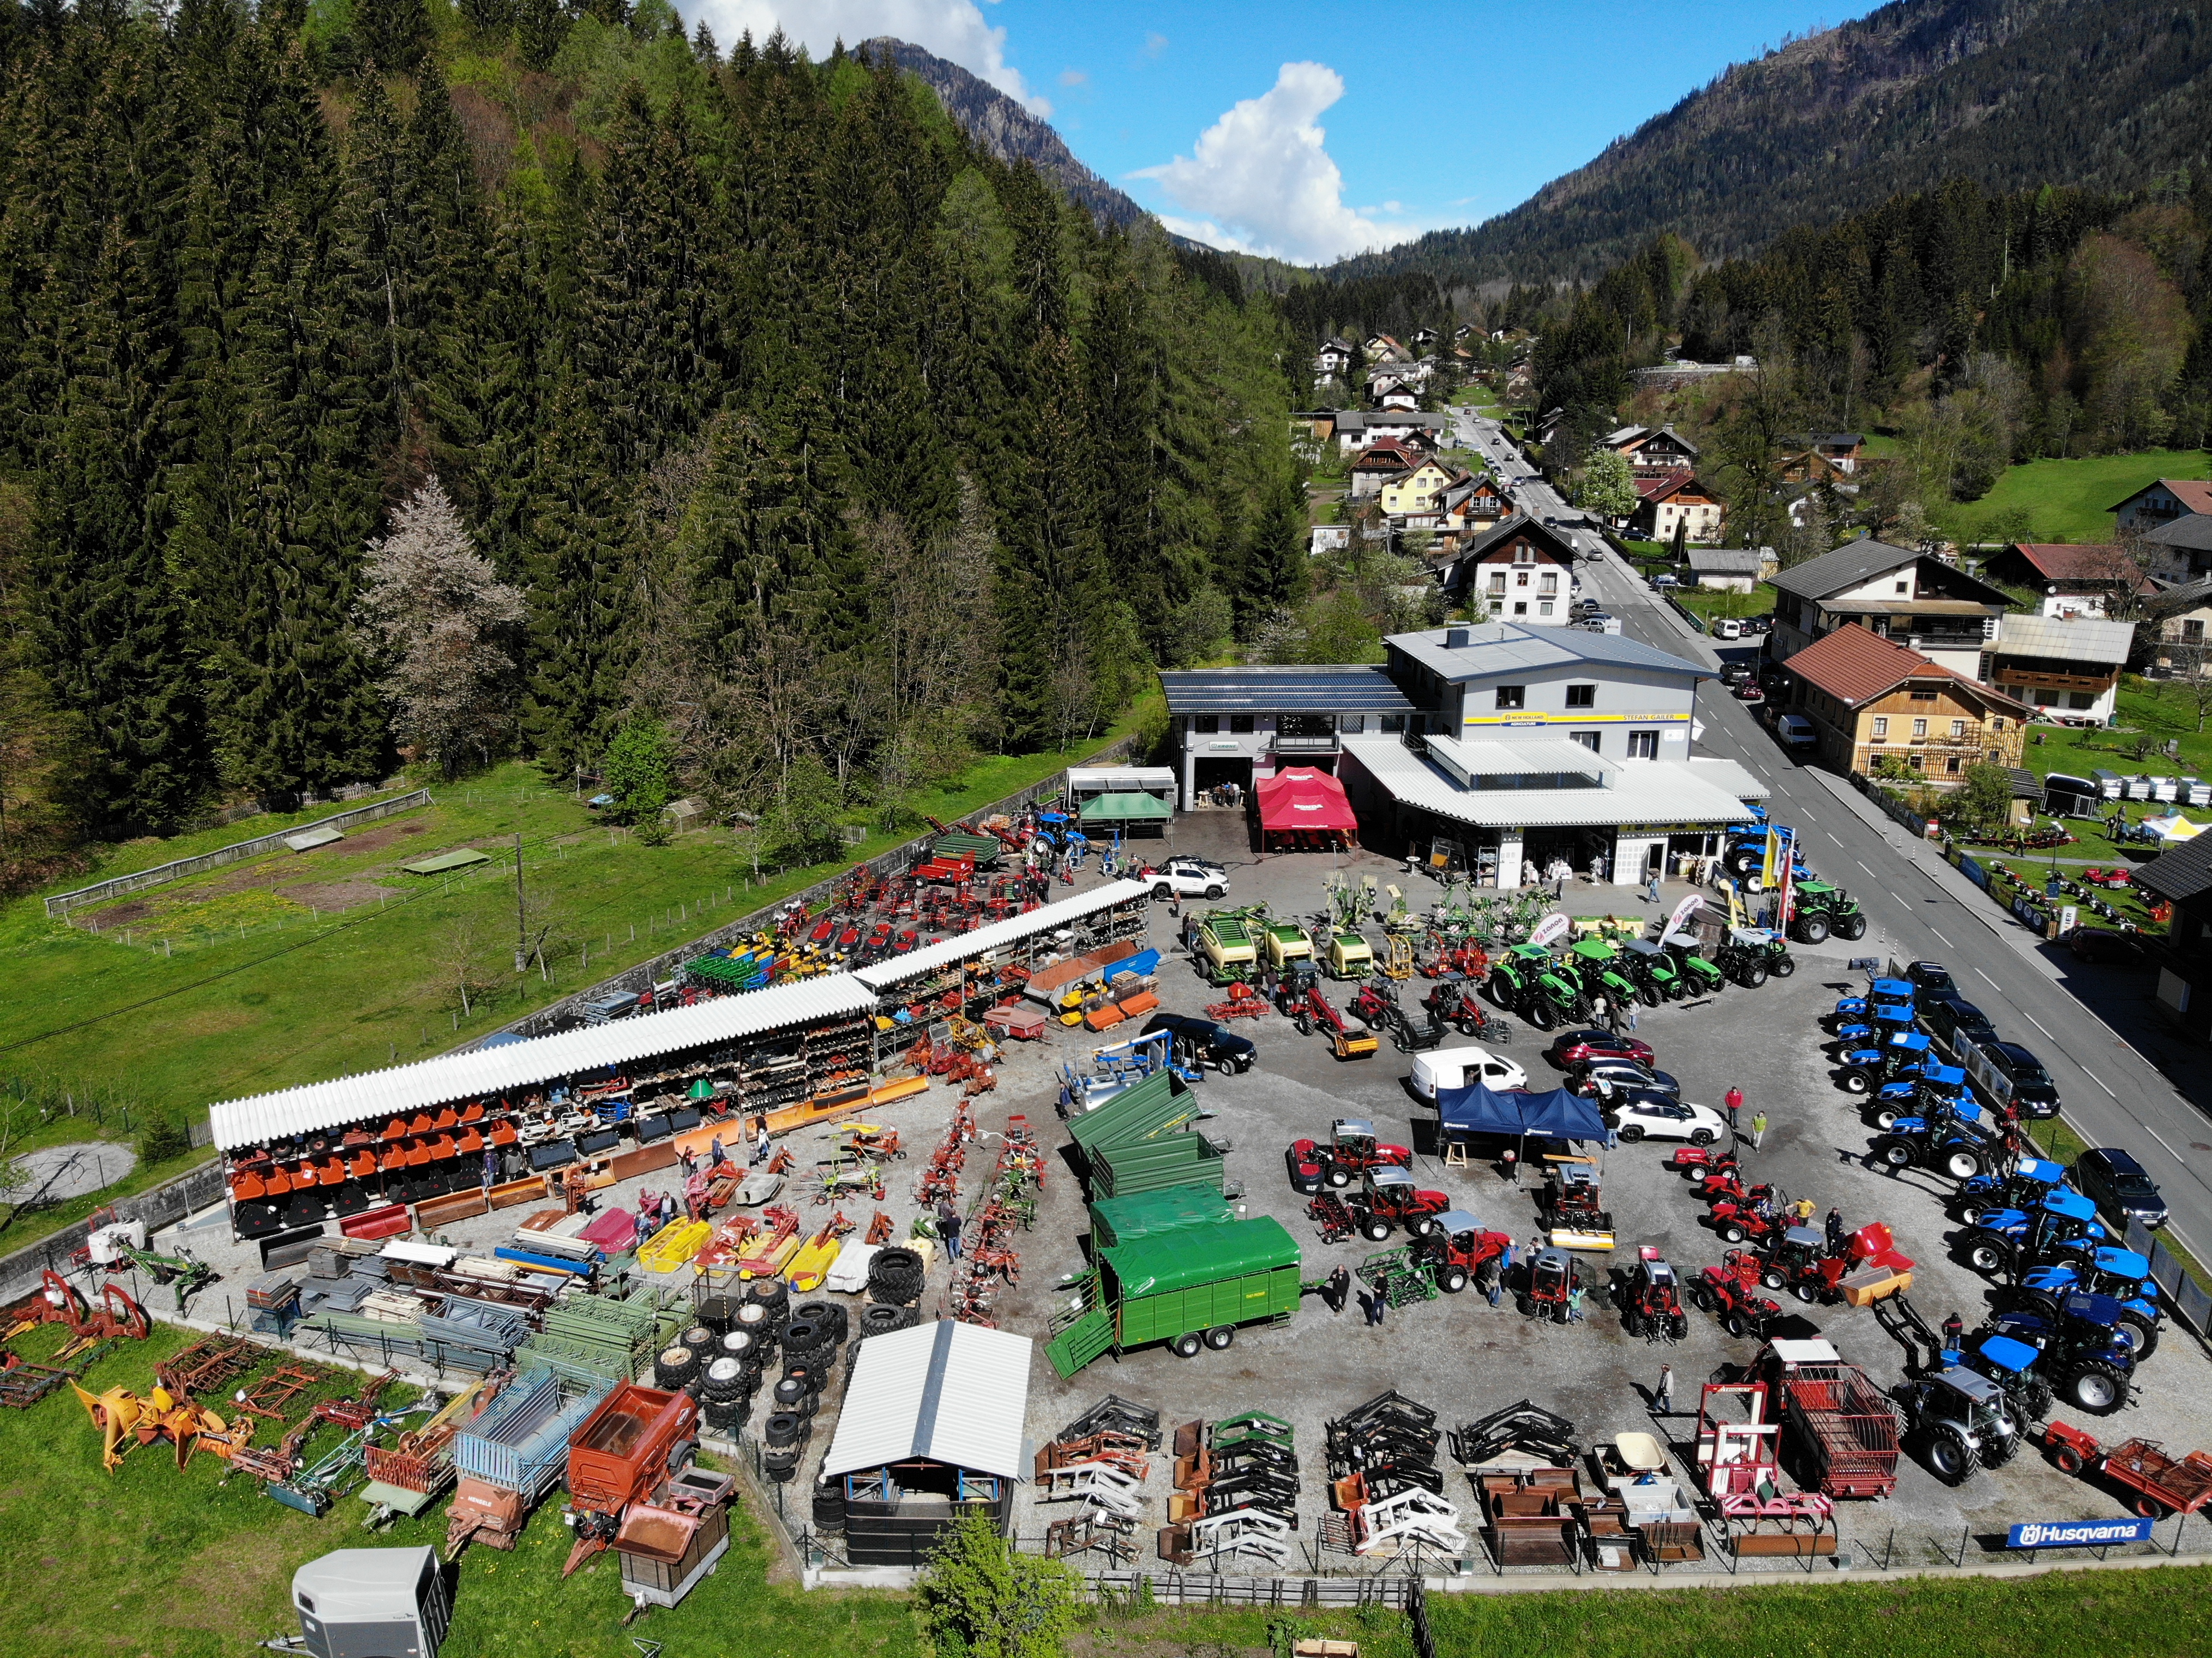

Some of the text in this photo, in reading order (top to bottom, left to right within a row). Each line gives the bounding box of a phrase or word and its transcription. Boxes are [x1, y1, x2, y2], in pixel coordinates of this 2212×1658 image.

[1680, 898, 1698, 915] zanon
[1542, 917, 1563, 934] zanon
[468, 1496, 492, 1507] MENGELE
[2041, 1525, 2136, 1541] Husqvarna
